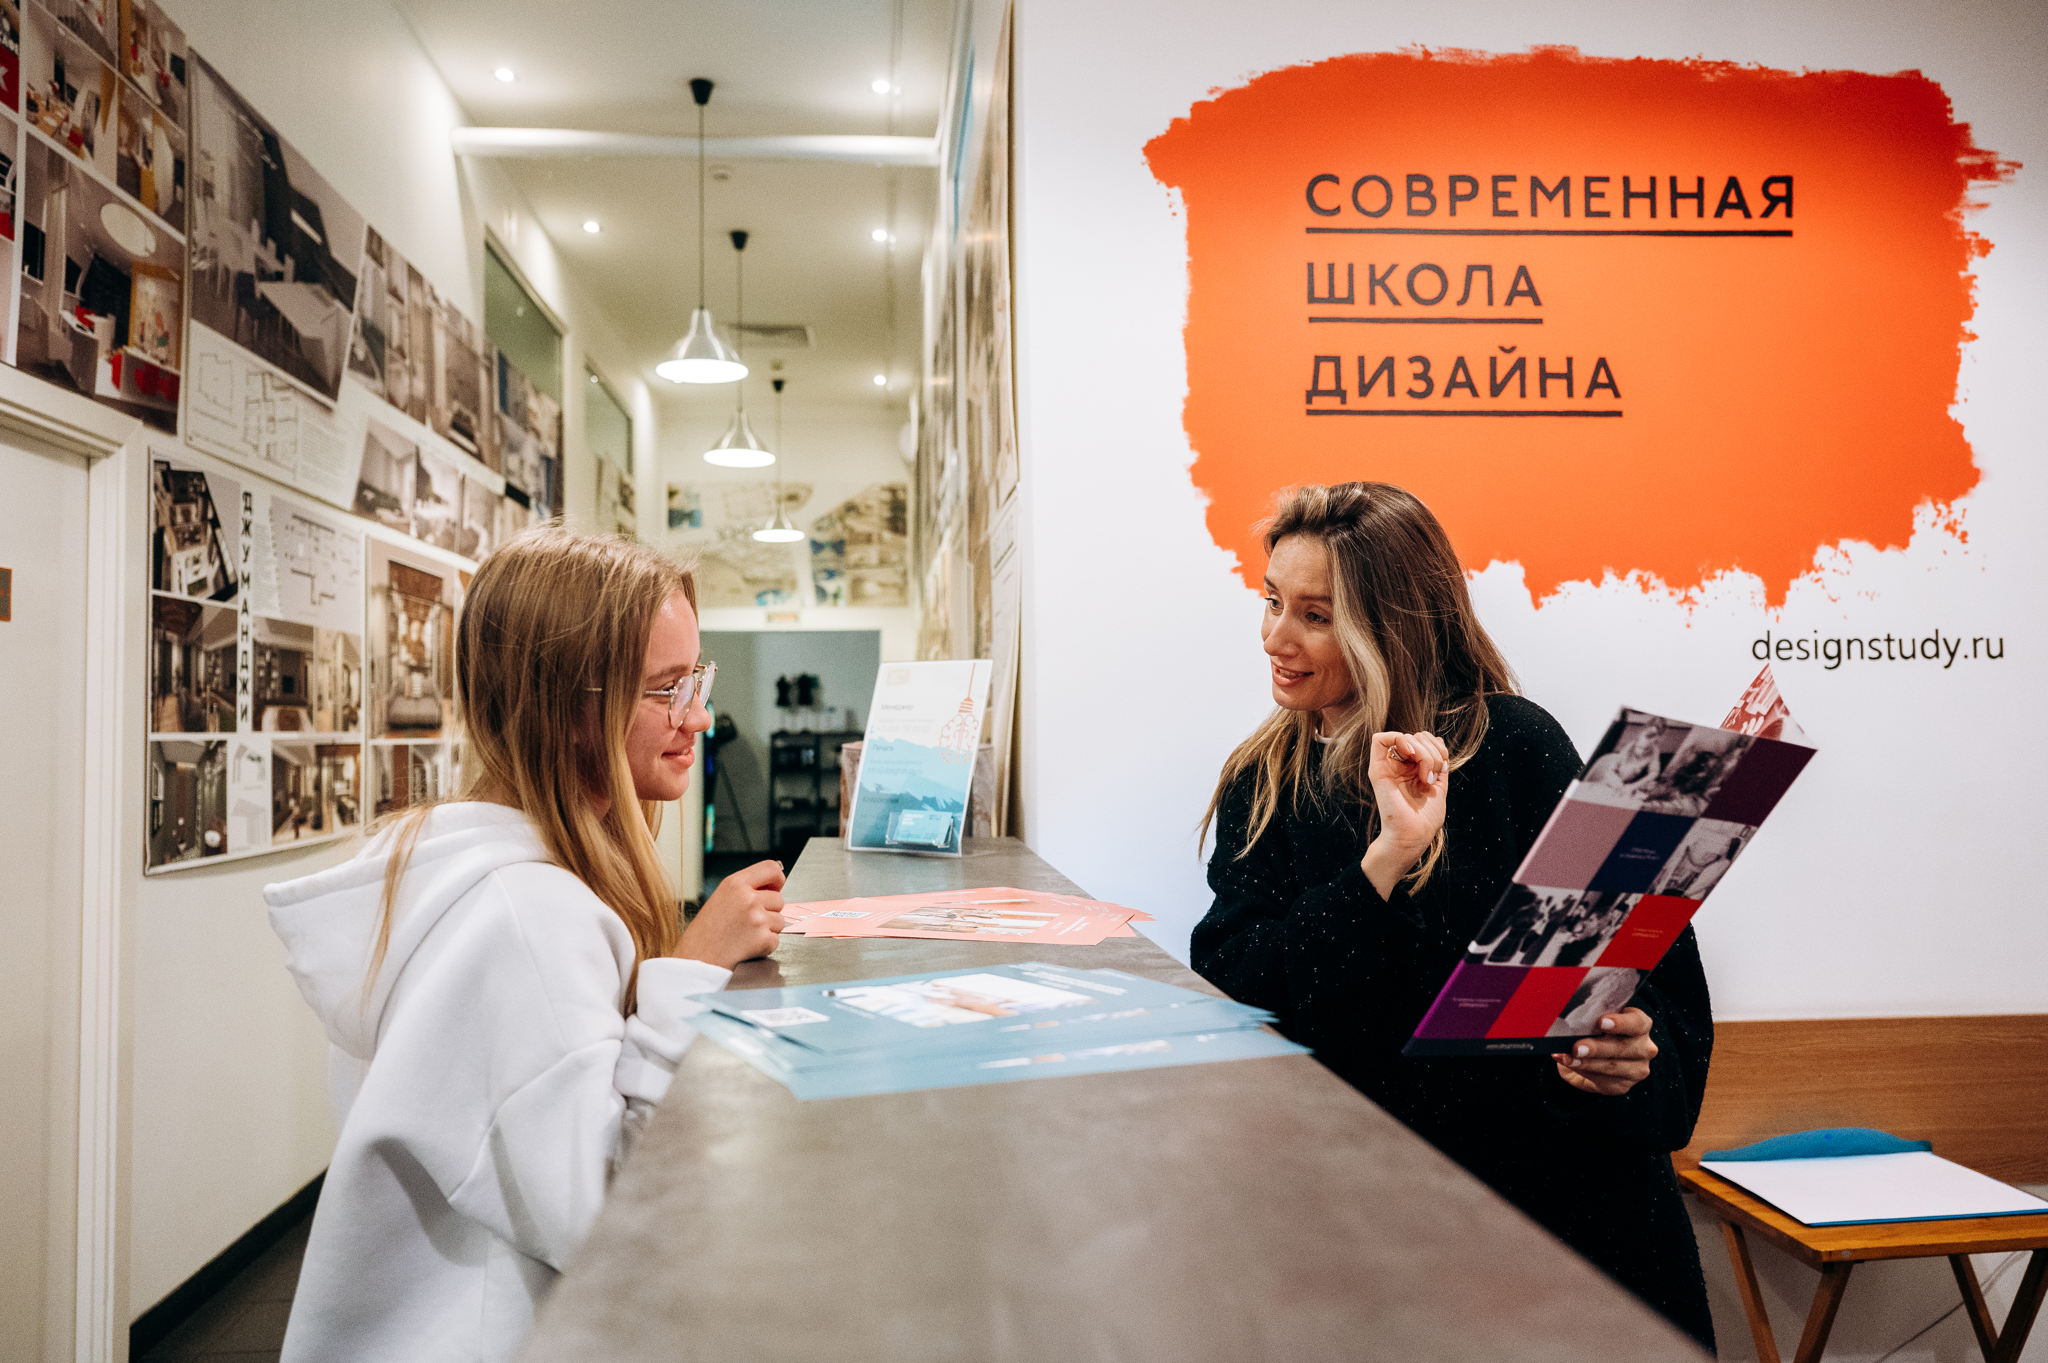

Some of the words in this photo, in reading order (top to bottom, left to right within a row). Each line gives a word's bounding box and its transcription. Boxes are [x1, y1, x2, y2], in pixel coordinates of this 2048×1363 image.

[1305, 173, 1794, 219] СОВРЕМЕННАЯ
[1306, 262, 1543, 306] ШКОЛА
[1305, 346, 1622, 405] ДИЗАЙНА
[239, 491, 252, 723] ДЖУМАНДЖИ
[1752, 629, 2004, 670] designstudy.ru
